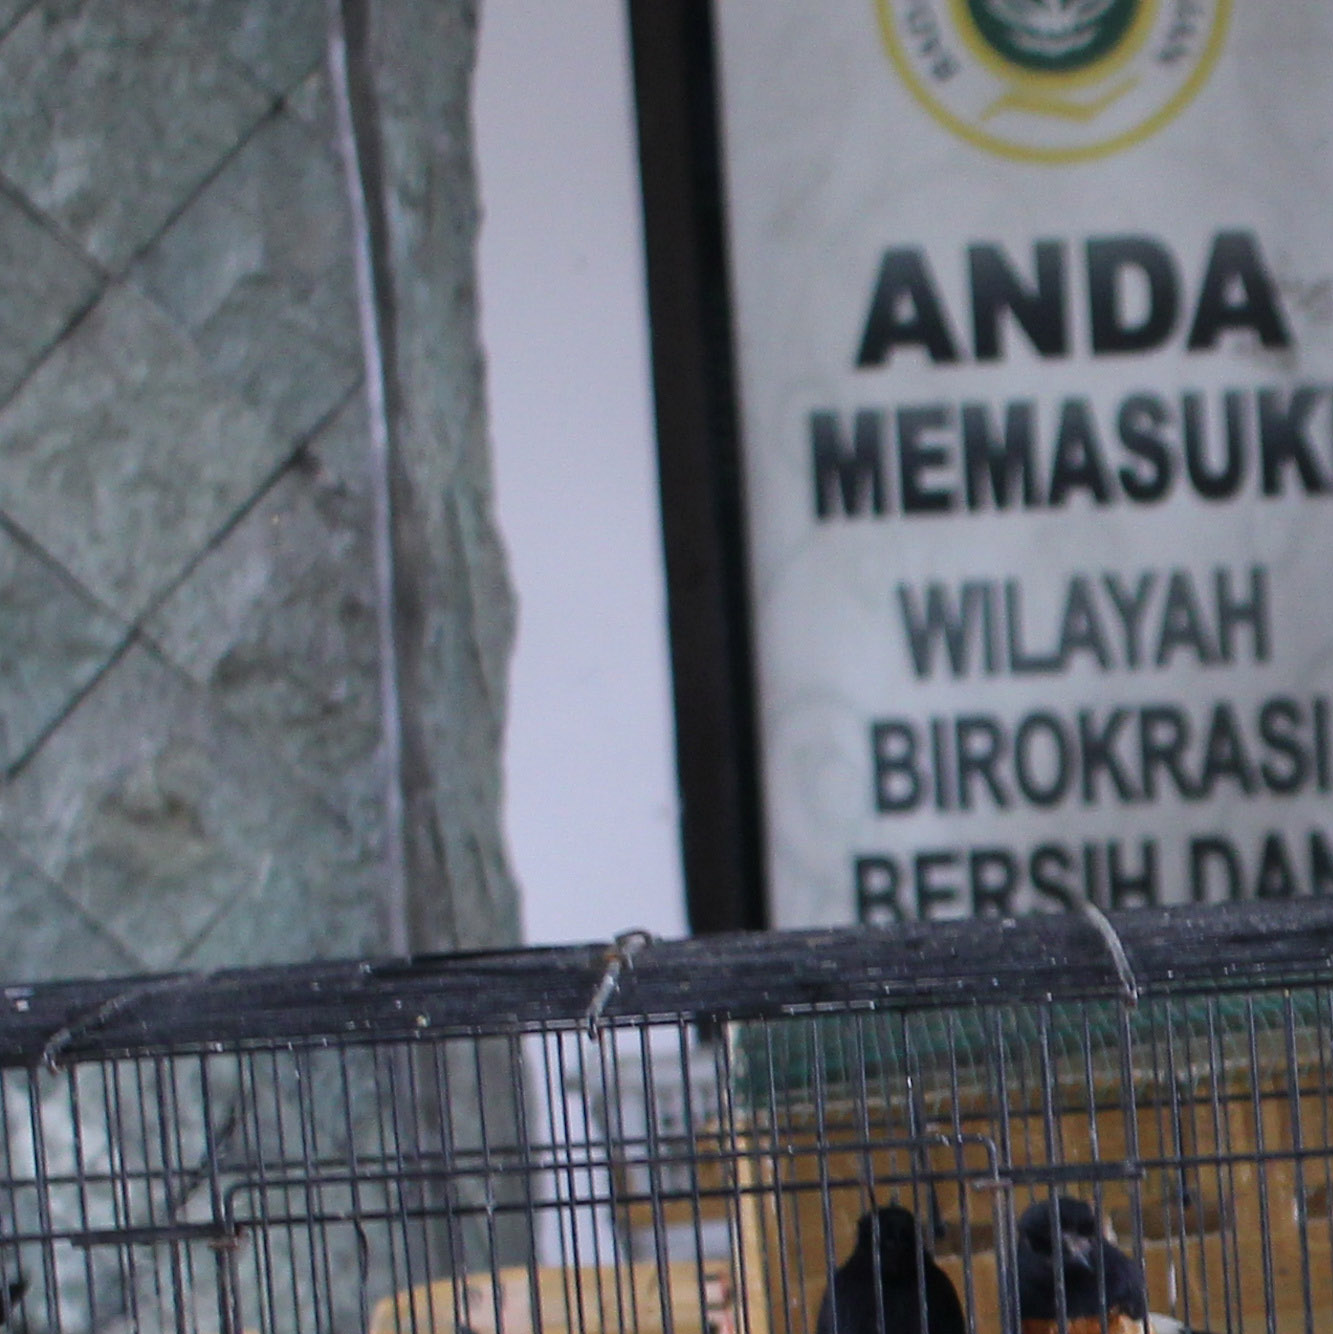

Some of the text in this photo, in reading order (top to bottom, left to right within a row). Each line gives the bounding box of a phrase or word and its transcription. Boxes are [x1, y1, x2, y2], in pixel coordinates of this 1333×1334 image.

[855, 229, 1292, 369] ANDA
[897, 564, 1270, 680] WILAYAH
[853, 837, 1157, 923] BERSIH
